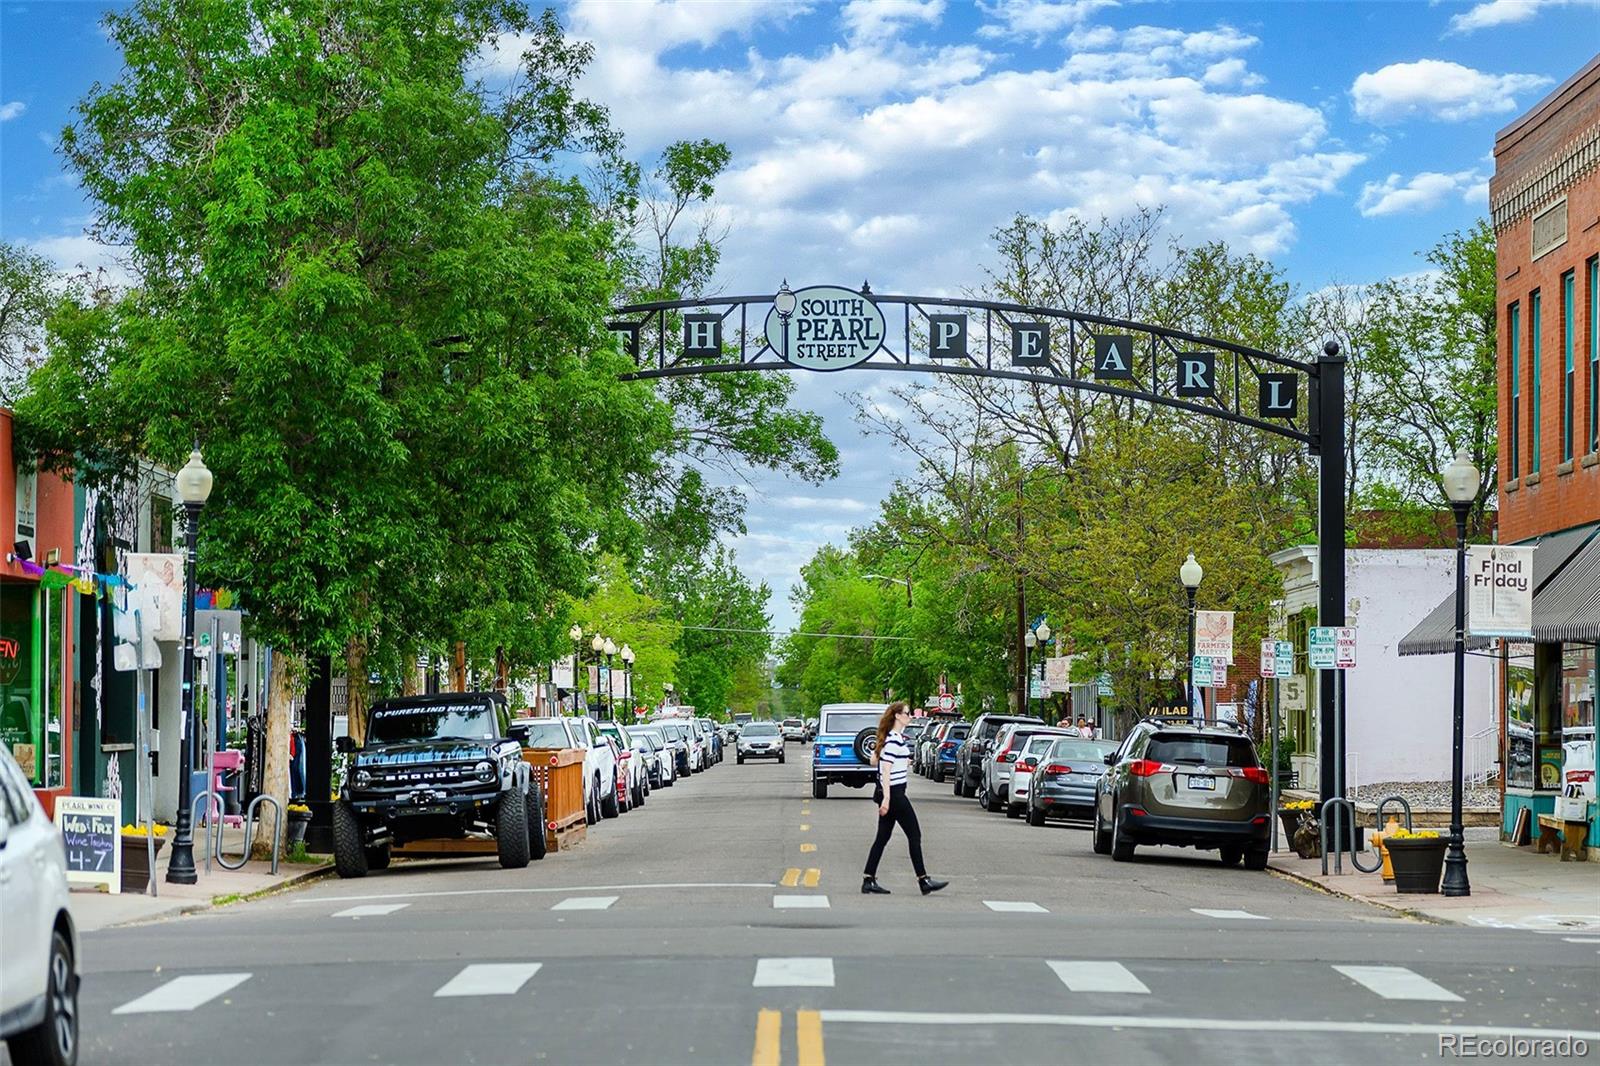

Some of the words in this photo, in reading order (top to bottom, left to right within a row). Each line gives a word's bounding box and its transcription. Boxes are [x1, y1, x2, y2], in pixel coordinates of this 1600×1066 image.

[801, 298, 865, 316] SOUTH
[796, 318, 880, 350] PEARL
[797, 344, 858, 361] STREET
[1482, 560, 1522, 573] Final
[1474, 574, 1528, 592] Friday
[1341, 630, 1351, 638] NO
[1195, 657, 1200, 667] 2
[1287, 682, 1300, 701] 5
[384, 707, 446, 717] PUREBLIND
[65, 832, 88, 847] Wine
[69, 850, 107, 871] 4-7
